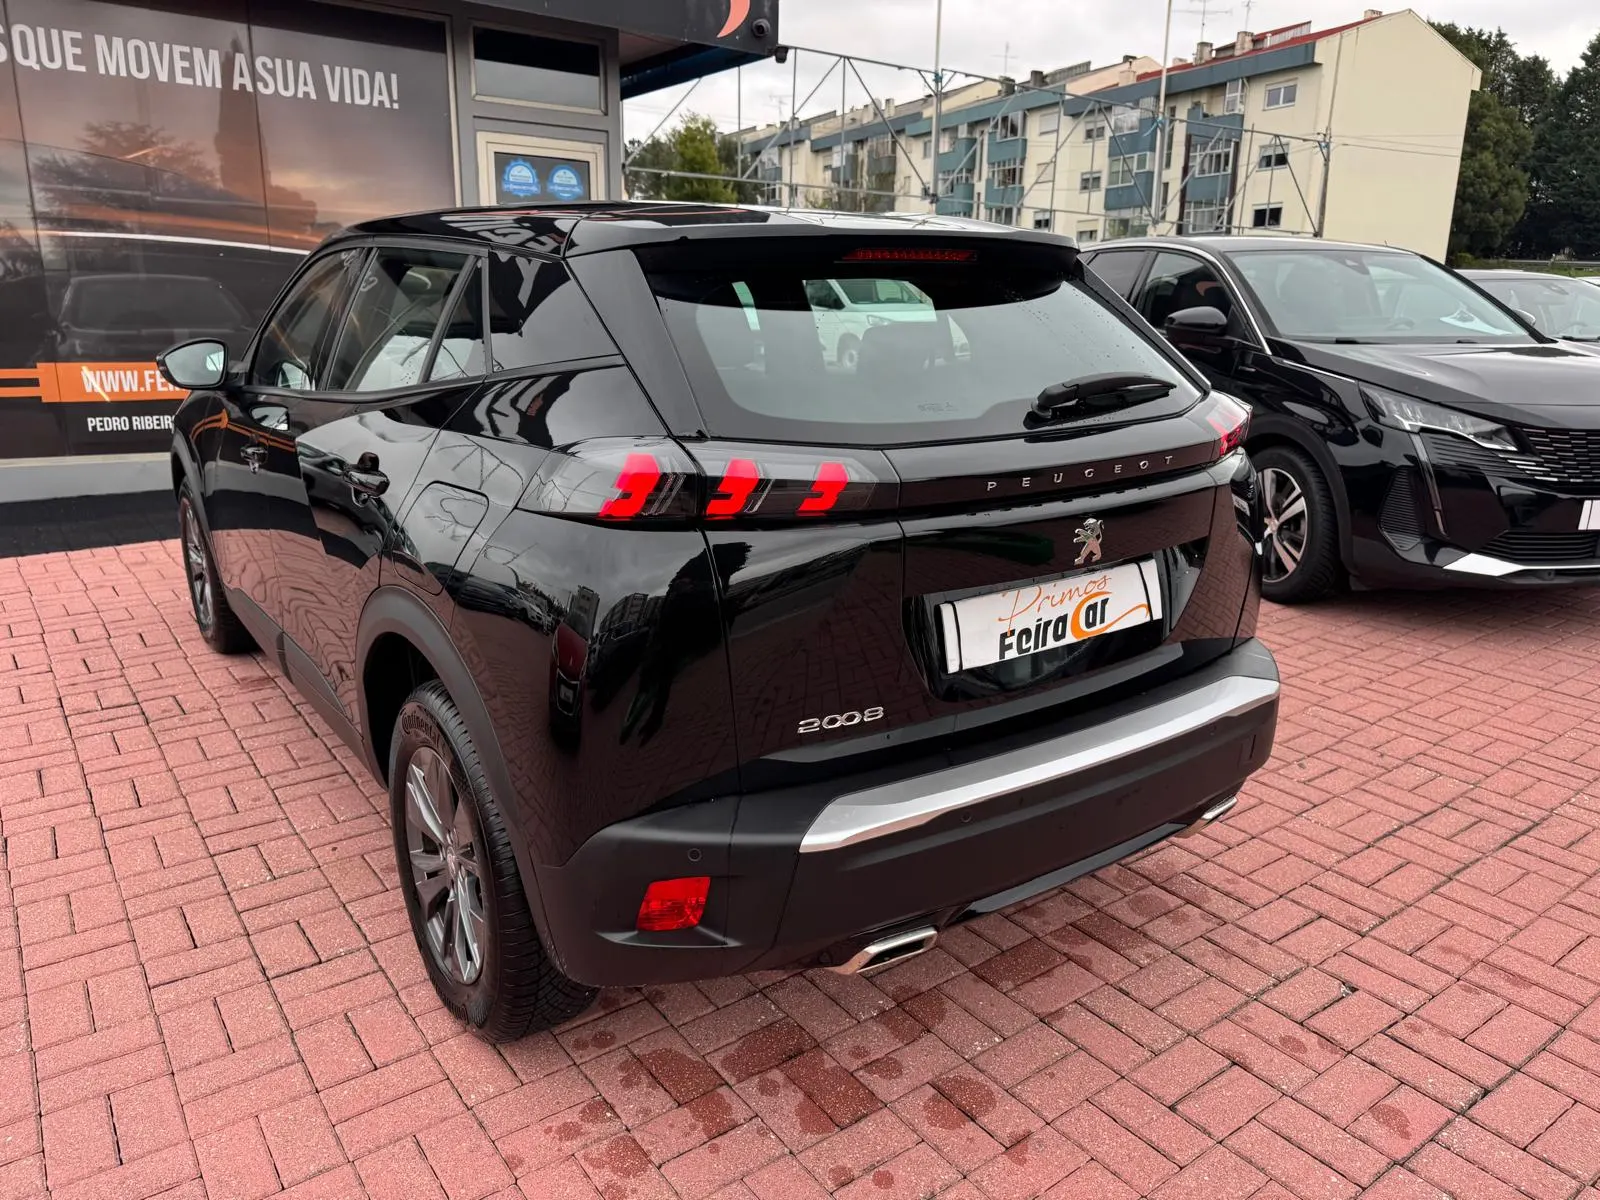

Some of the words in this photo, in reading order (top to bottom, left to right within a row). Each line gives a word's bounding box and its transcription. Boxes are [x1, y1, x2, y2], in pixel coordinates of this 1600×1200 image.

[11, 23, 87, 73] QUE
[94, 34, 223, 89] MOVEM
[322, 64, 400, 110] VIDA!
[81, 369, 186, 393] WWW.FE
[87, 416, 130, 432] PEDRO
[986, 454, 1174, 492] PEUGEOT
[998, 574, 1112, 638] Primos
[999, 591, 1114, 660] FeiraCar
[797, 706, 885, 734] 2008
